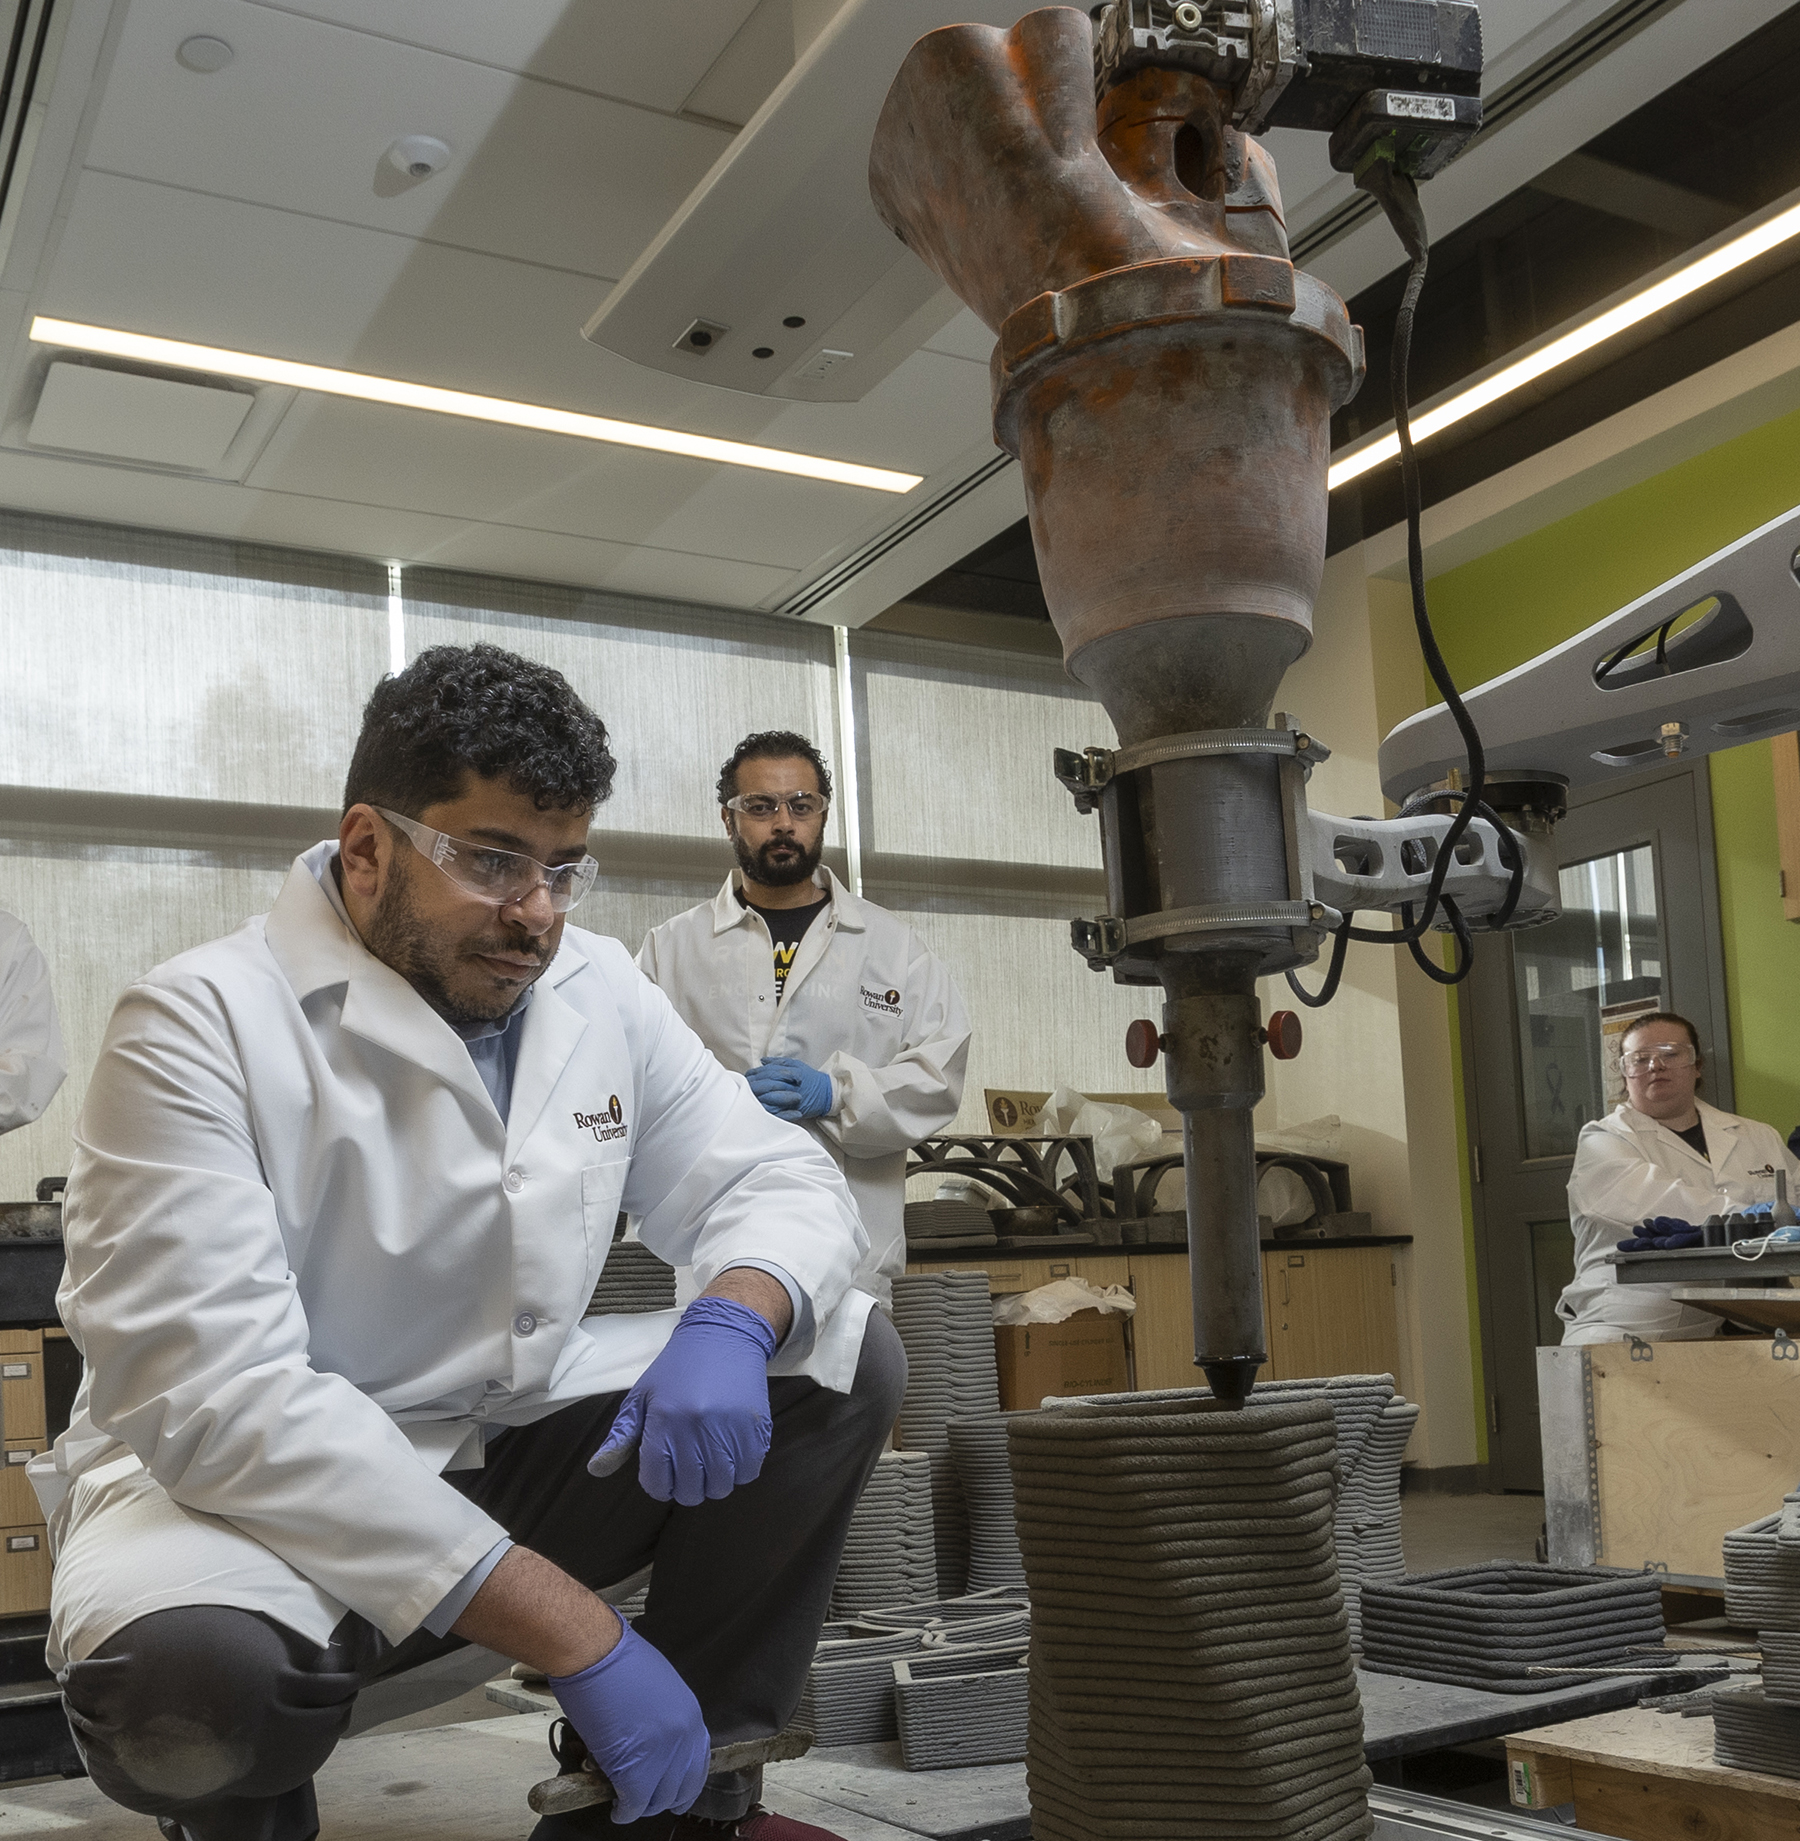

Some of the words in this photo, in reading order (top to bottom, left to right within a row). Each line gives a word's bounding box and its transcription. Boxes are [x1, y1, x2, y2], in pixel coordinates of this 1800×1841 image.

[860, 985, 885, 1001] Rowan
[864, 997, 903, 1017] University
[573, 1111, 611, 1129] Rowan
